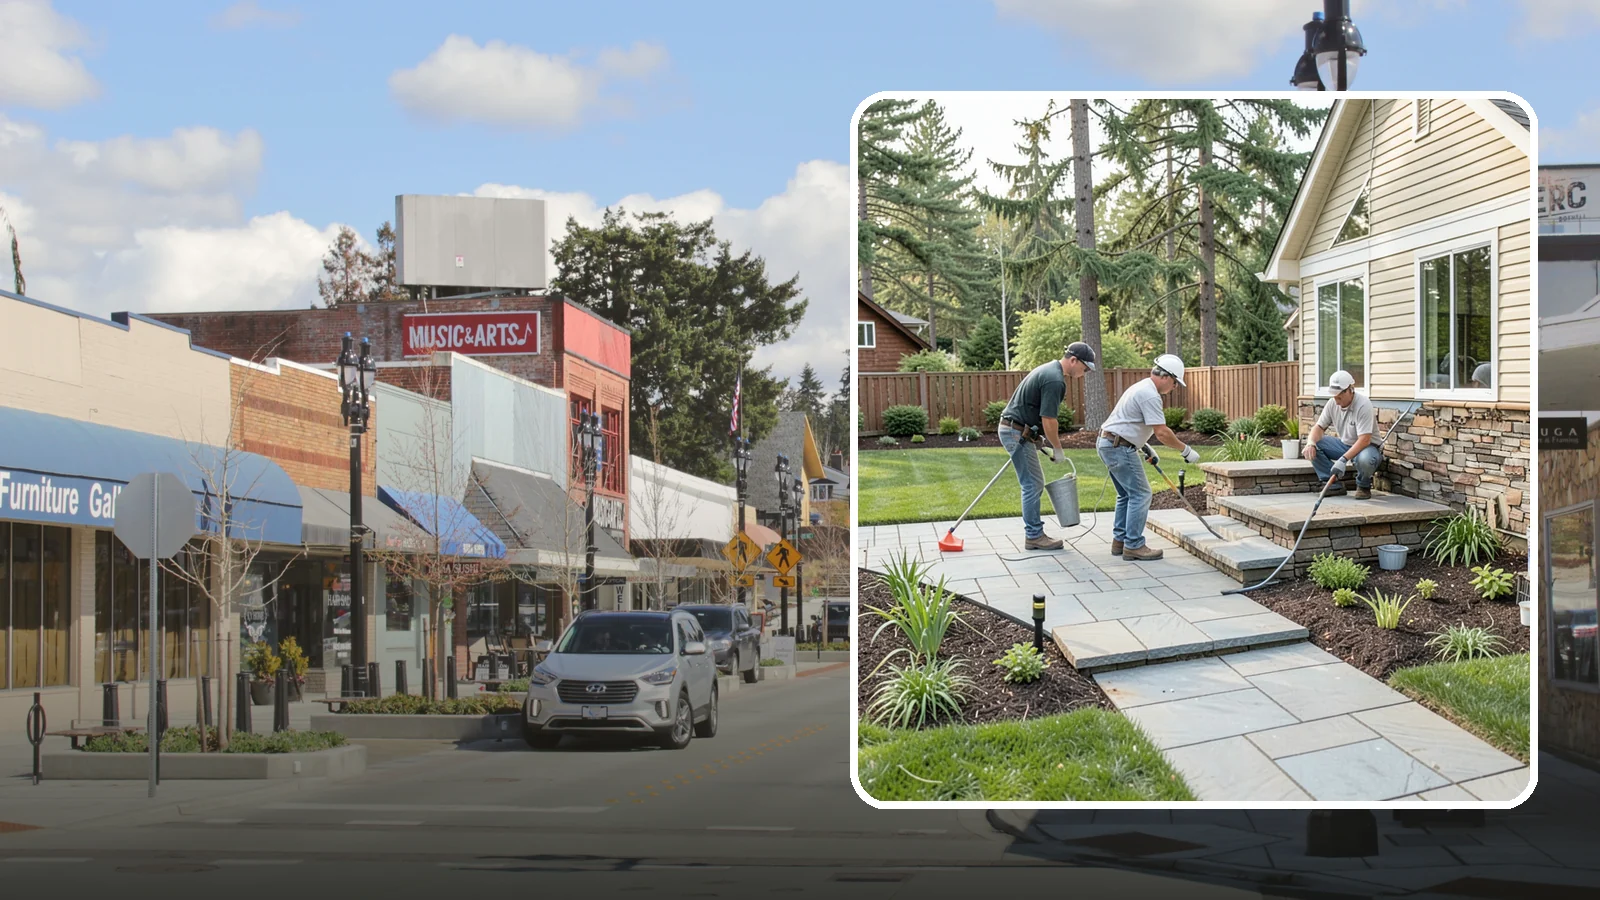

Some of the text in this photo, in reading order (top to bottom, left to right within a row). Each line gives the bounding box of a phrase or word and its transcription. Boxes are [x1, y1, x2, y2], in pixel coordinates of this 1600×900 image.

[0, 471, 122, 519] Furniture Gal
[453, 563, 479, 574] SUSHI
